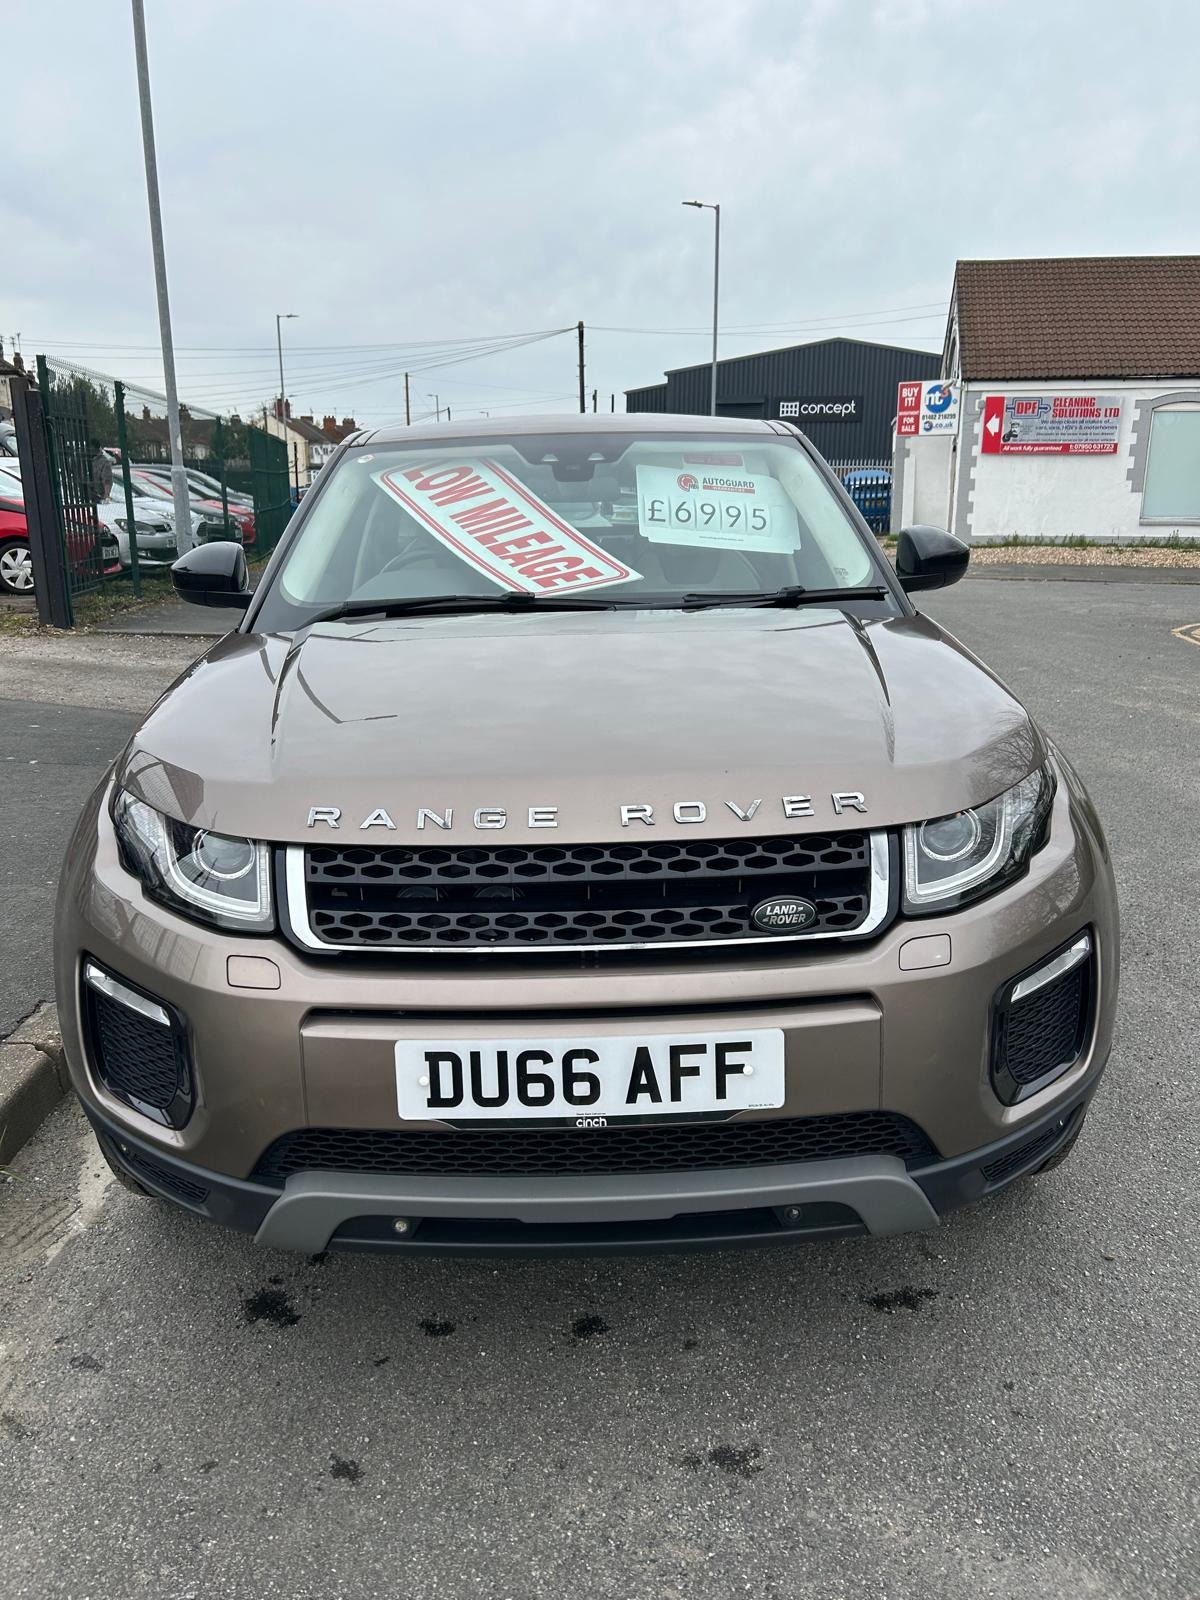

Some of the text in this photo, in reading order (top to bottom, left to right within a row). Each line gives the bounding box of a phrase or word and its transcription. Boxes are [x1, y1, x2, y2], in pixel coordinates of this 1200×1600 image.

[902, 387, 919, 398] BUY
[904, 397, 915, 407] IT!
[1016, 401, 1037, 415] DPF
[1053, 397, 1096, 407] CLEANING
[800, 400, 856, 417] concept
[1052, 407, 1120, 418] SOLUTIONS LTD
[903, 416, 914, 424] FOR
[901, 425, 916, 433] SALE
[702, 477, 755, 489] AUTOGUARD
[648, 499, 767, 531] £6995
[403, 460, 604, 588] LOW MILEAGE
[307, 791, 868, 830] RANGE ROVER
[766, 904, 797, 916] LAND
[769, 913, 806, 925] ROVER
[424, 1041, 753, 1108] DU66 AFF
[576, 1116, 607, 1127] cinch
